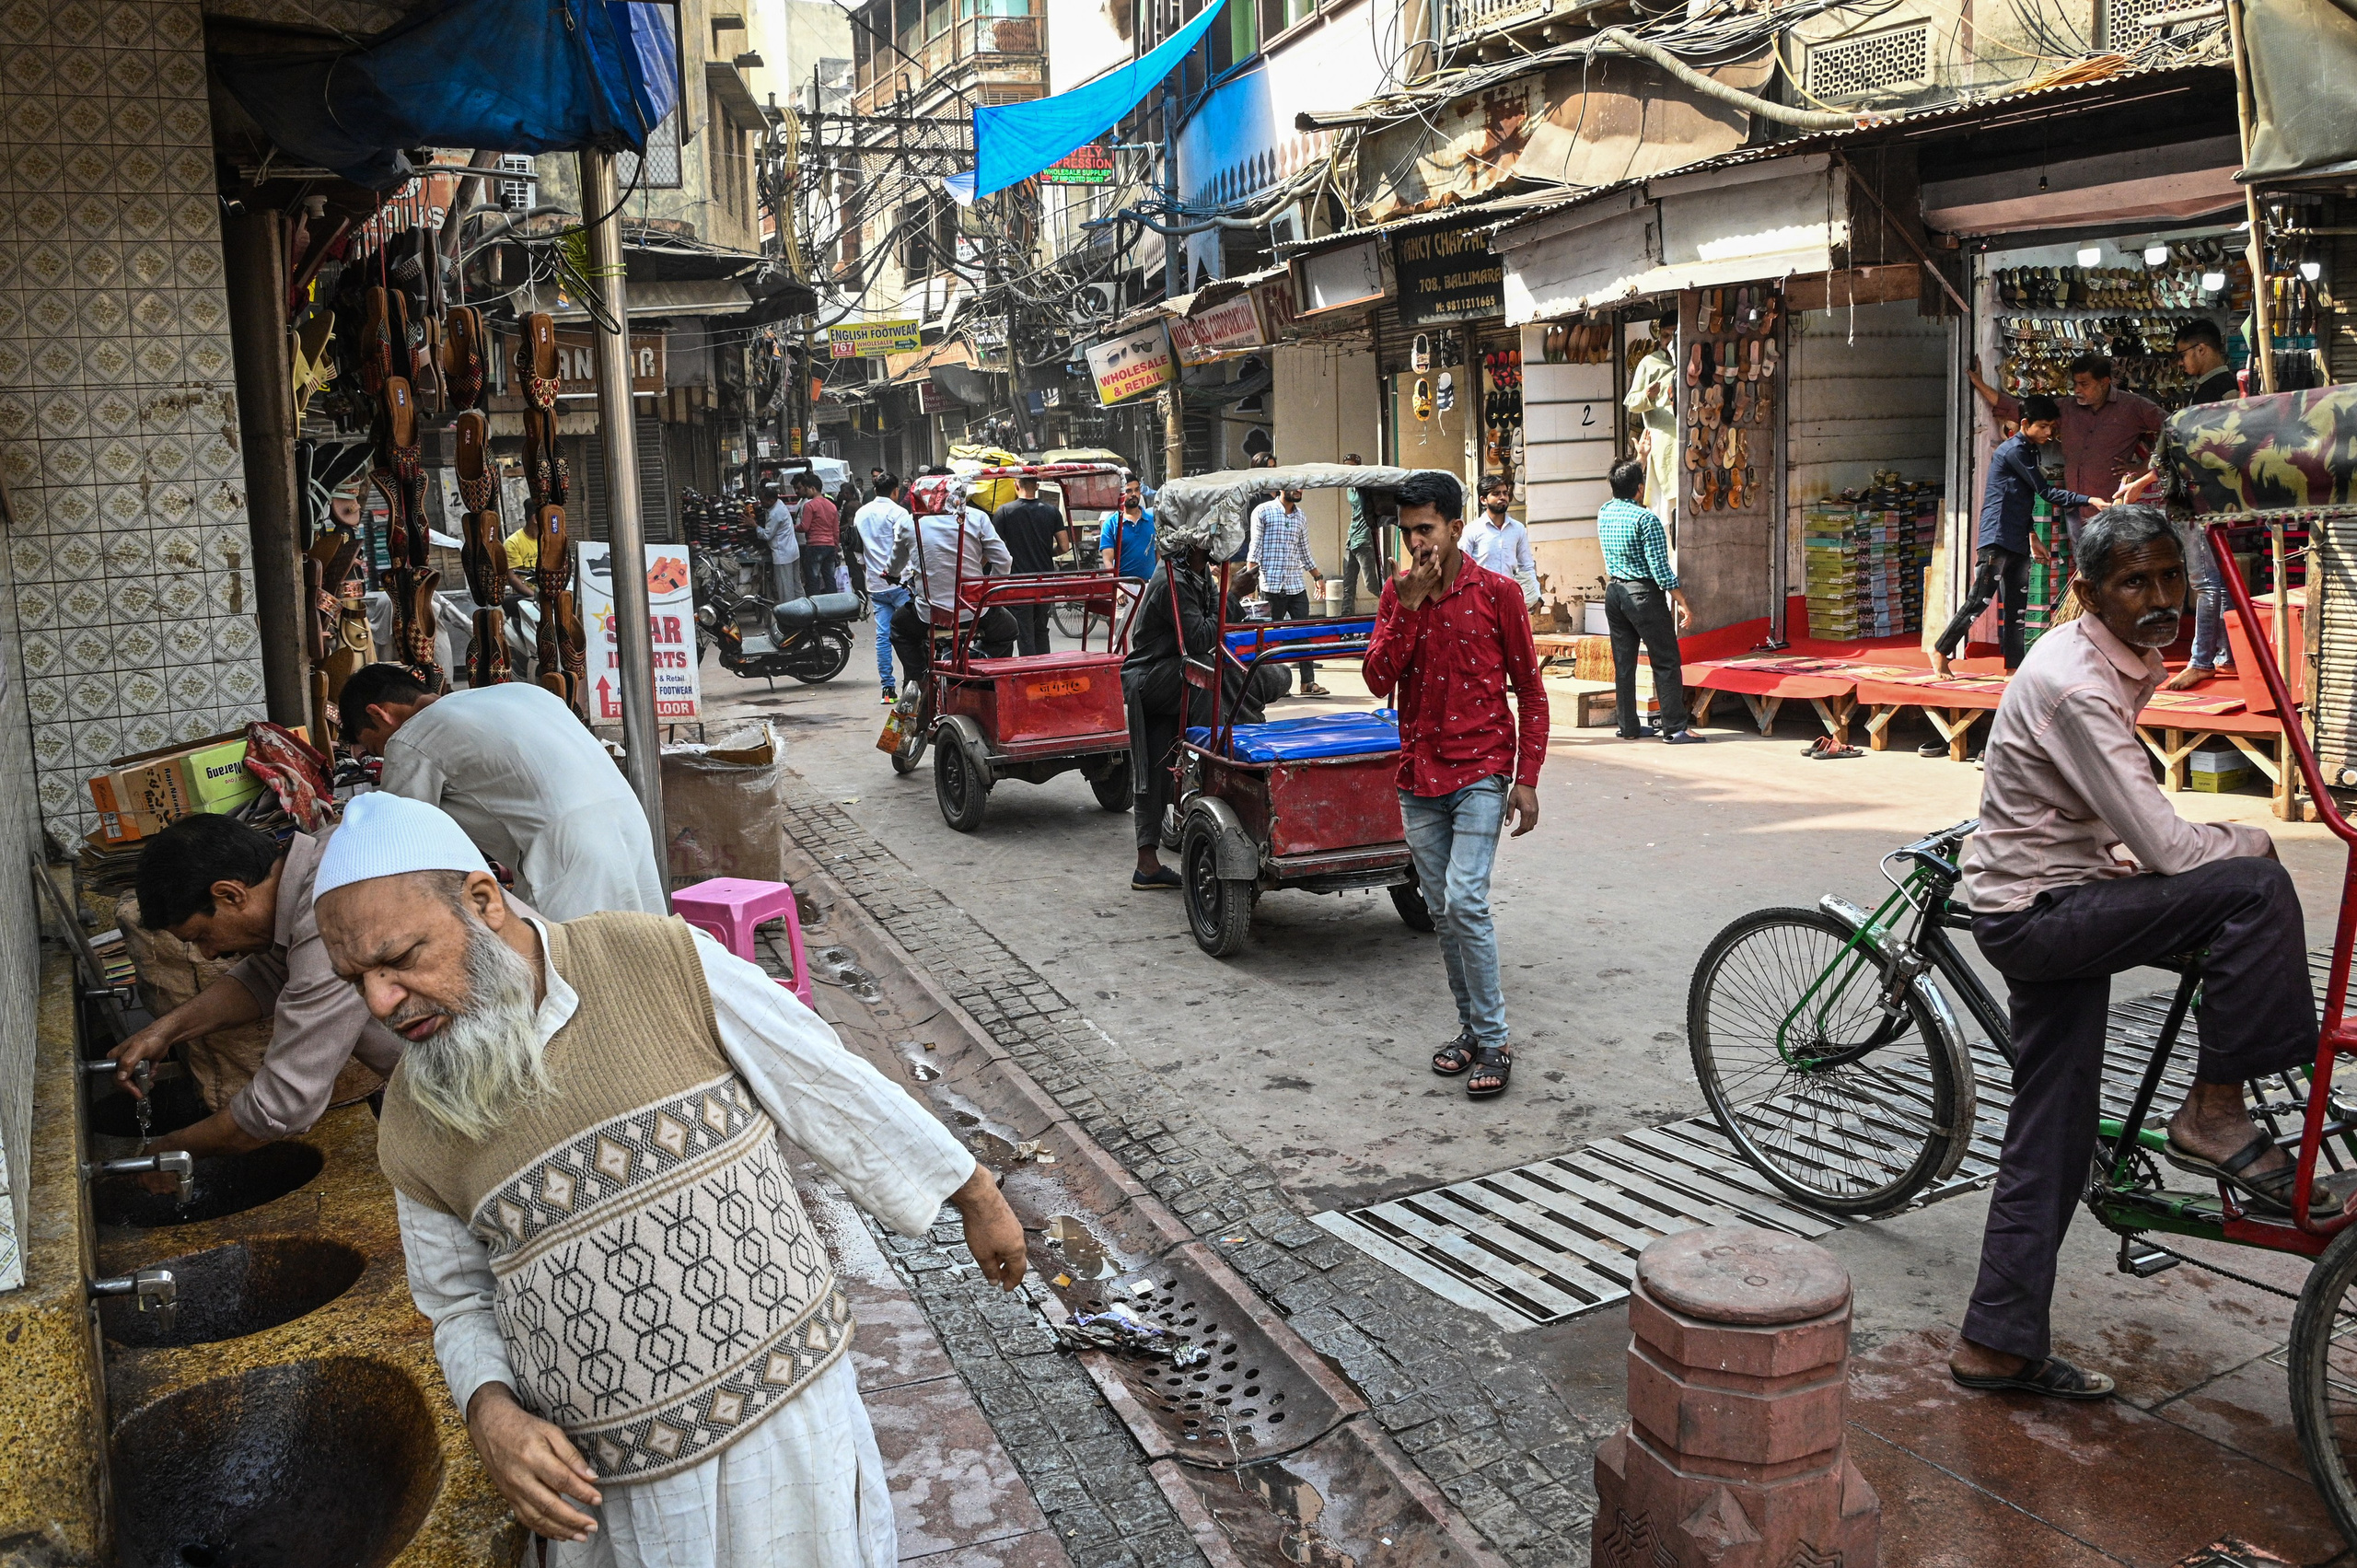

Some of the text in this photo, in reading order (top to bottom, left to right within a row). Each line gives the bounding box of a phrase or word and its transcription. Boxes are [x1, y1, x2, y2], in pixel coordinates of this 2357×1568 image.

[1070, 147, 1103, 158] VELY
[1050, 157, 1112, 169] PRESSION
[1419, 266, 1502, 293] 708, BALLIMARA
[1435, 302, 1446, 313] M:
[830, 322, 918, 342] ENGLISH FOOTWEAR
[832, 341, 854, 352] 767
[1099, 354, 1169, 388] WHOLESALE
[1113, 371, 1165, 398] & RETAIL
[924, 401, 944, 412] Boot
[1581, 404, 1596, 426] 2
[448, 492, 462, 507] 2
[606, 615, 682, 644] SAR
[608, 651, 688, 669] IRTS
[667, 674, 685, 682] Retail
[659, 685, 693, 695] FOOTWEAR
[656, 702, 690, 715] LOOR
[205, 761, 242, 780] Narang
